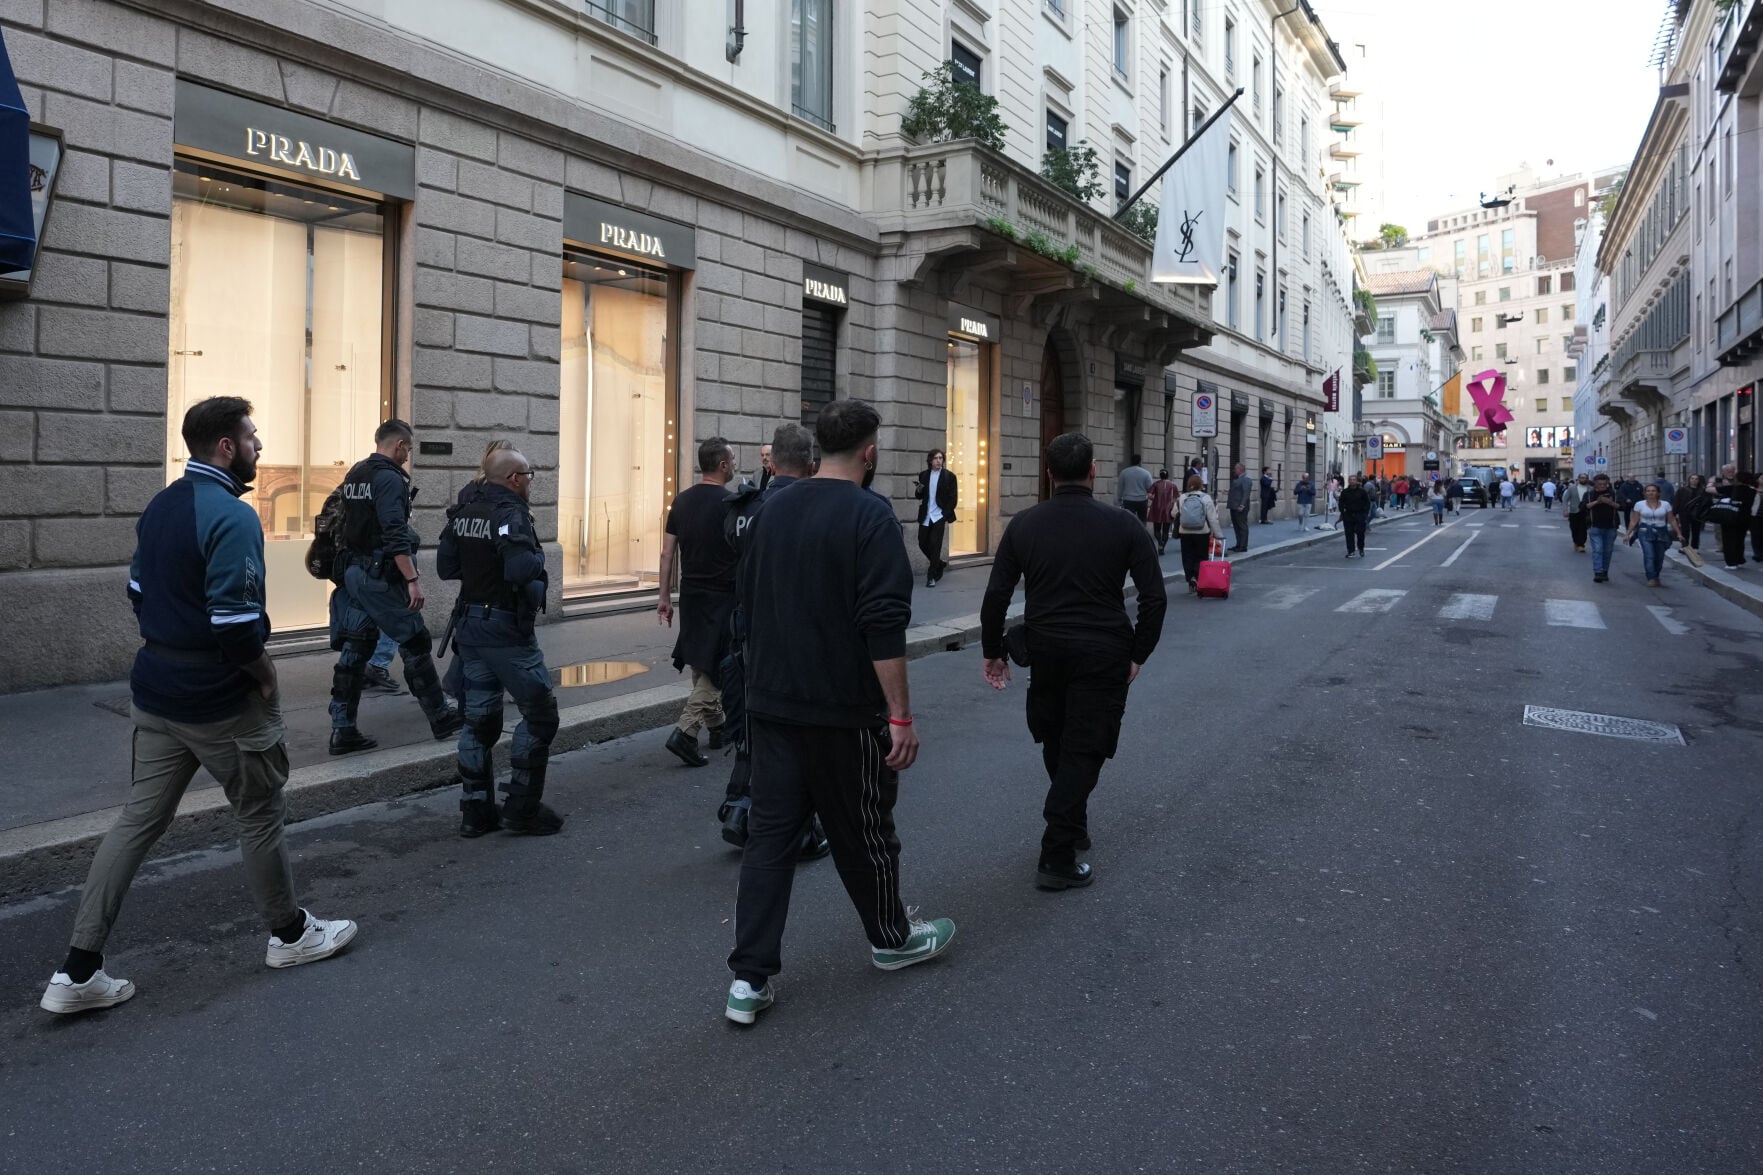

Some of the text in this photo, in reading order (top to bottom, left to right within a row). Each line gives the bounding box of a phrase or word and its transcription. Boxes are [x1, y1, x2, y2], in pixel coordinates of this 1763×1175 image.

[246, 127, 361, 181] PRADA
[601, 222, 665, 257] PRADA
[805, 278, 847, 304] PRADA
[960, 317, 988, 338] PRADA
[343, 482, 373, 500] POLIZIA
[453, 517, 492, 540] POLIZIA
